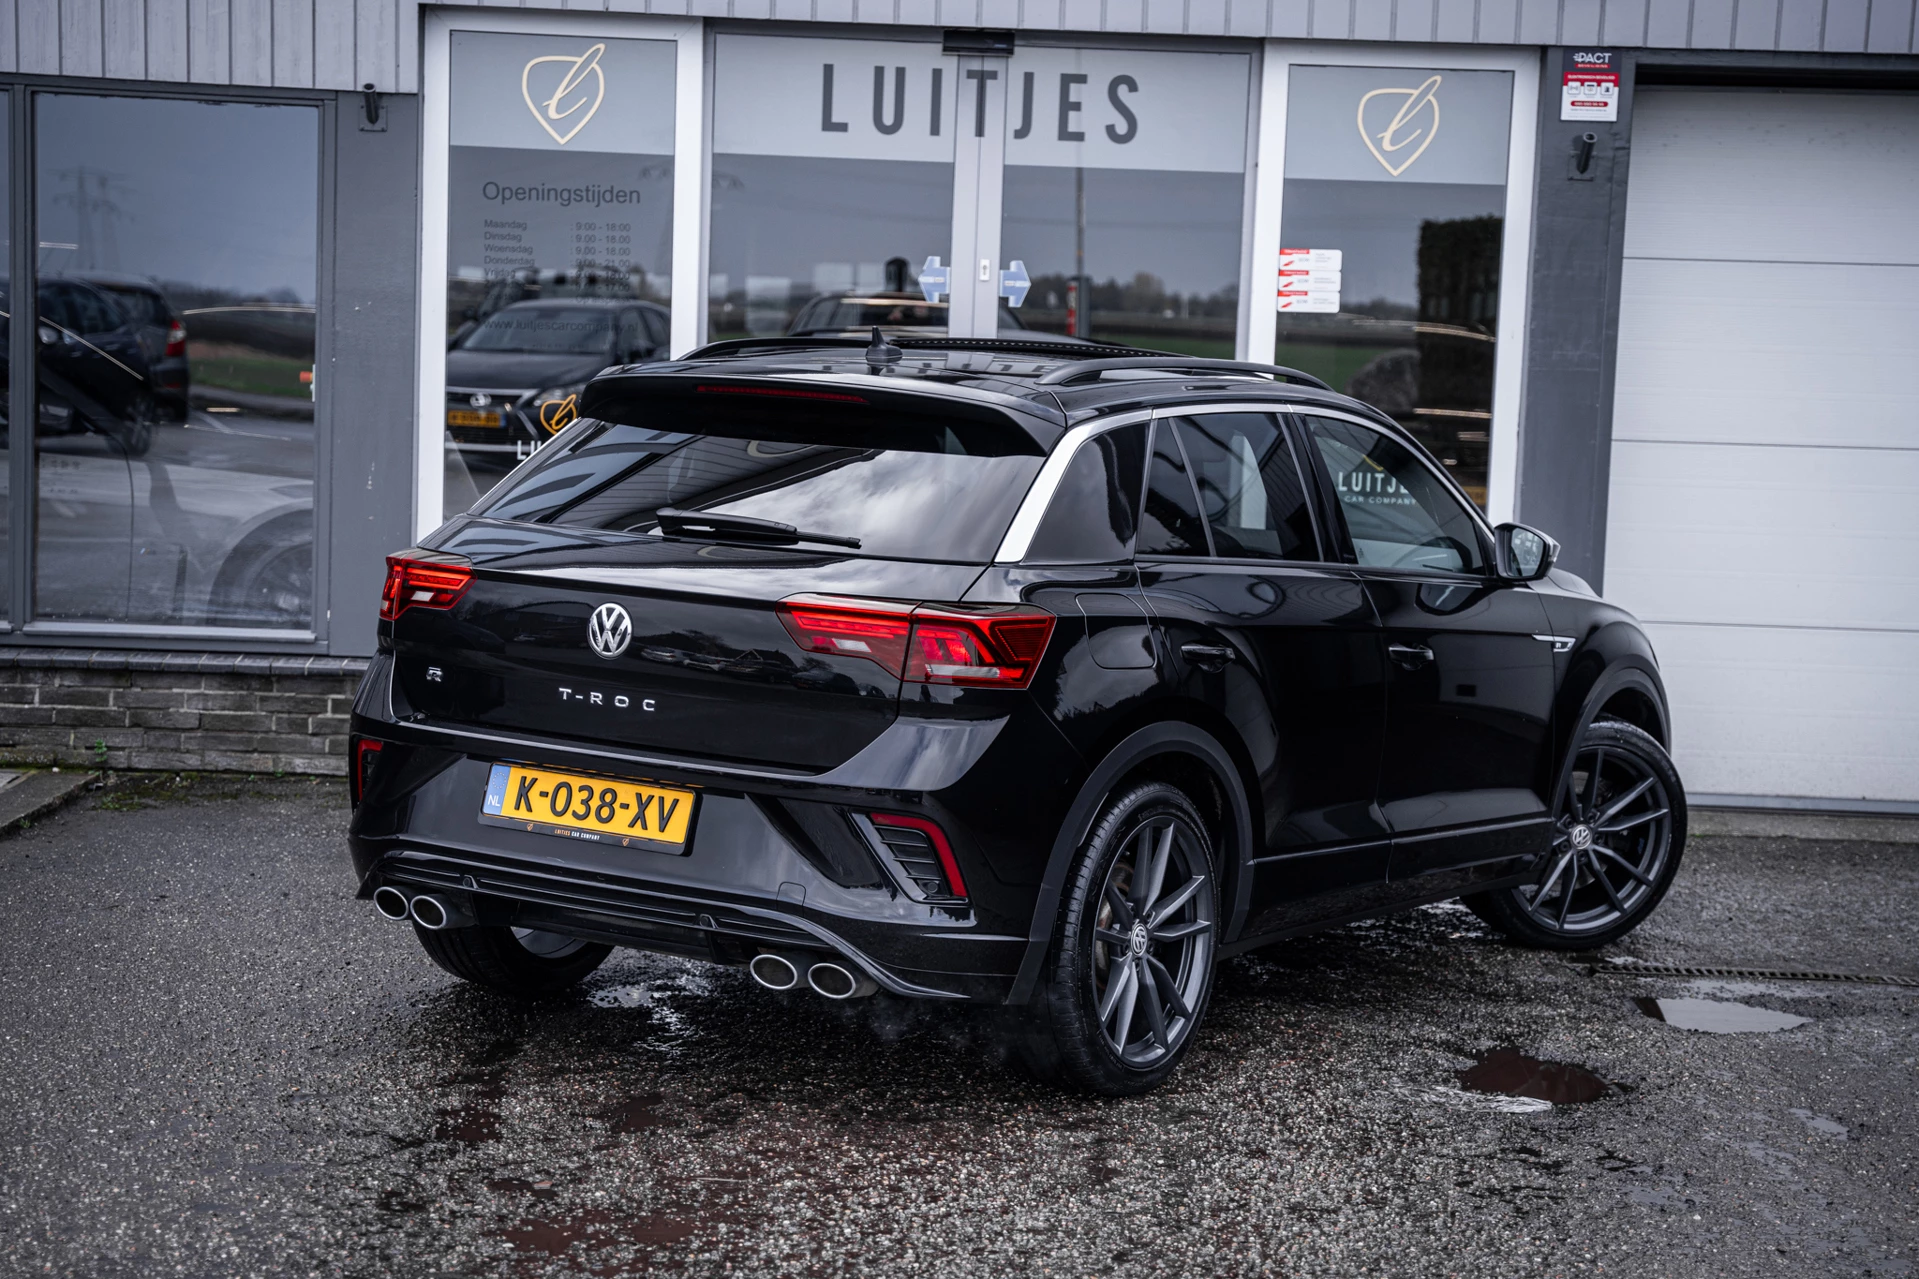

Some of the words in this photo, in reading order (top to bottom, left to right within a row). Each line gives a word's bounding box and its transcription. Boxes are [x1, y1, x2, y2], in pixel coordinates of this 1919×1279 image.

[1574, 52, 1612, 64] PACT
[821, 63, 1139, 145] LUITJES
[482, 181, 641, 208] Openingstijden
[484, 219, 527, 231] Maandag
[484, 231, 522, 243] Dinsdag
[484, 244, 533, 256] Woensdag
[484, 255, 535, 268] Donderdag
[484, 268, 516, 280] Vrijdag
[1344, 495, 1364, 503] CAR
[487, 794, 501, 807] NL
[514, 775, 680, 833] K-038-XV
